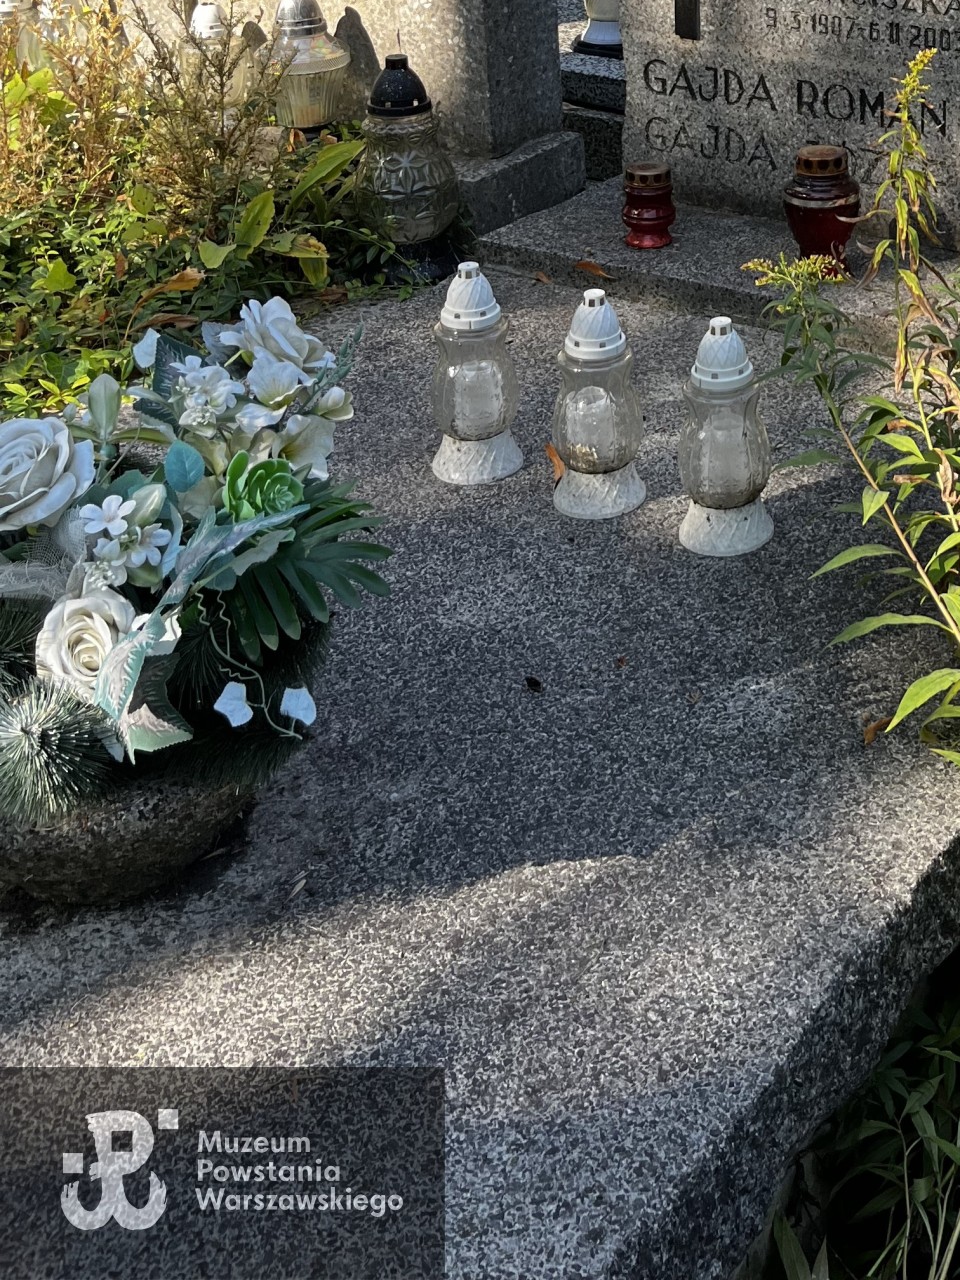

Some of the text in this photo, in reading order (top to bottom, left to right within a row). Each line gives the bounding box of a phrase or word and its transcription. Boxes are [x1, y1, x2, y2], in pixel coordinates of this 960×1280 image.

[643, 59, 947, 138] GAJDA ROMAN
[645, 116, 778, 171] GAJDA
